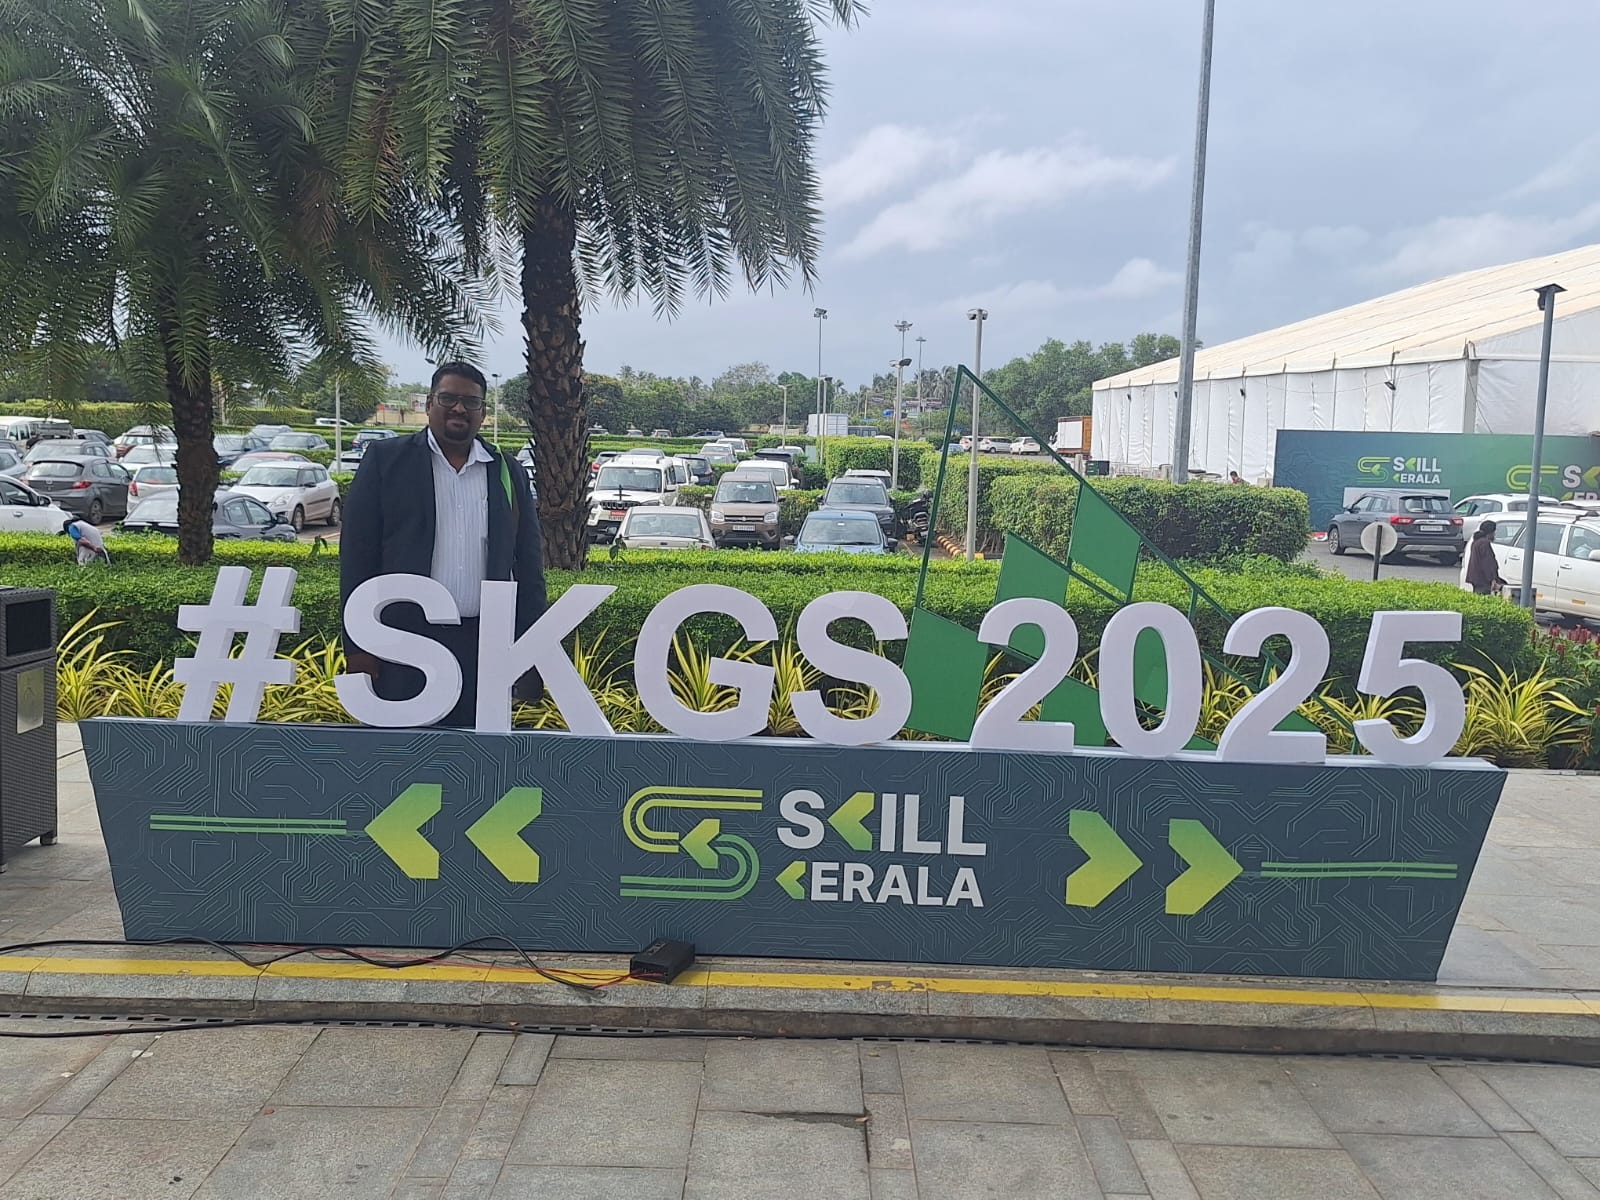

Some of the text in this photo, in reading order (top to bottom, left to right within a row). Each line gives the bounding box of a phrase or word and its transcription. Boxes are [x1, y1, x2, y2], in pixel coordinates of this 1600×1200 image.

[1392, 456, 1442, 473] SKILL
[1392, 473, 1441, 484] KERALA
[173, 566, 1466, 767] #SKGS 2025
[776, 789, 987, 856] SKILL
[775, 860, 984, 908] KERALA
